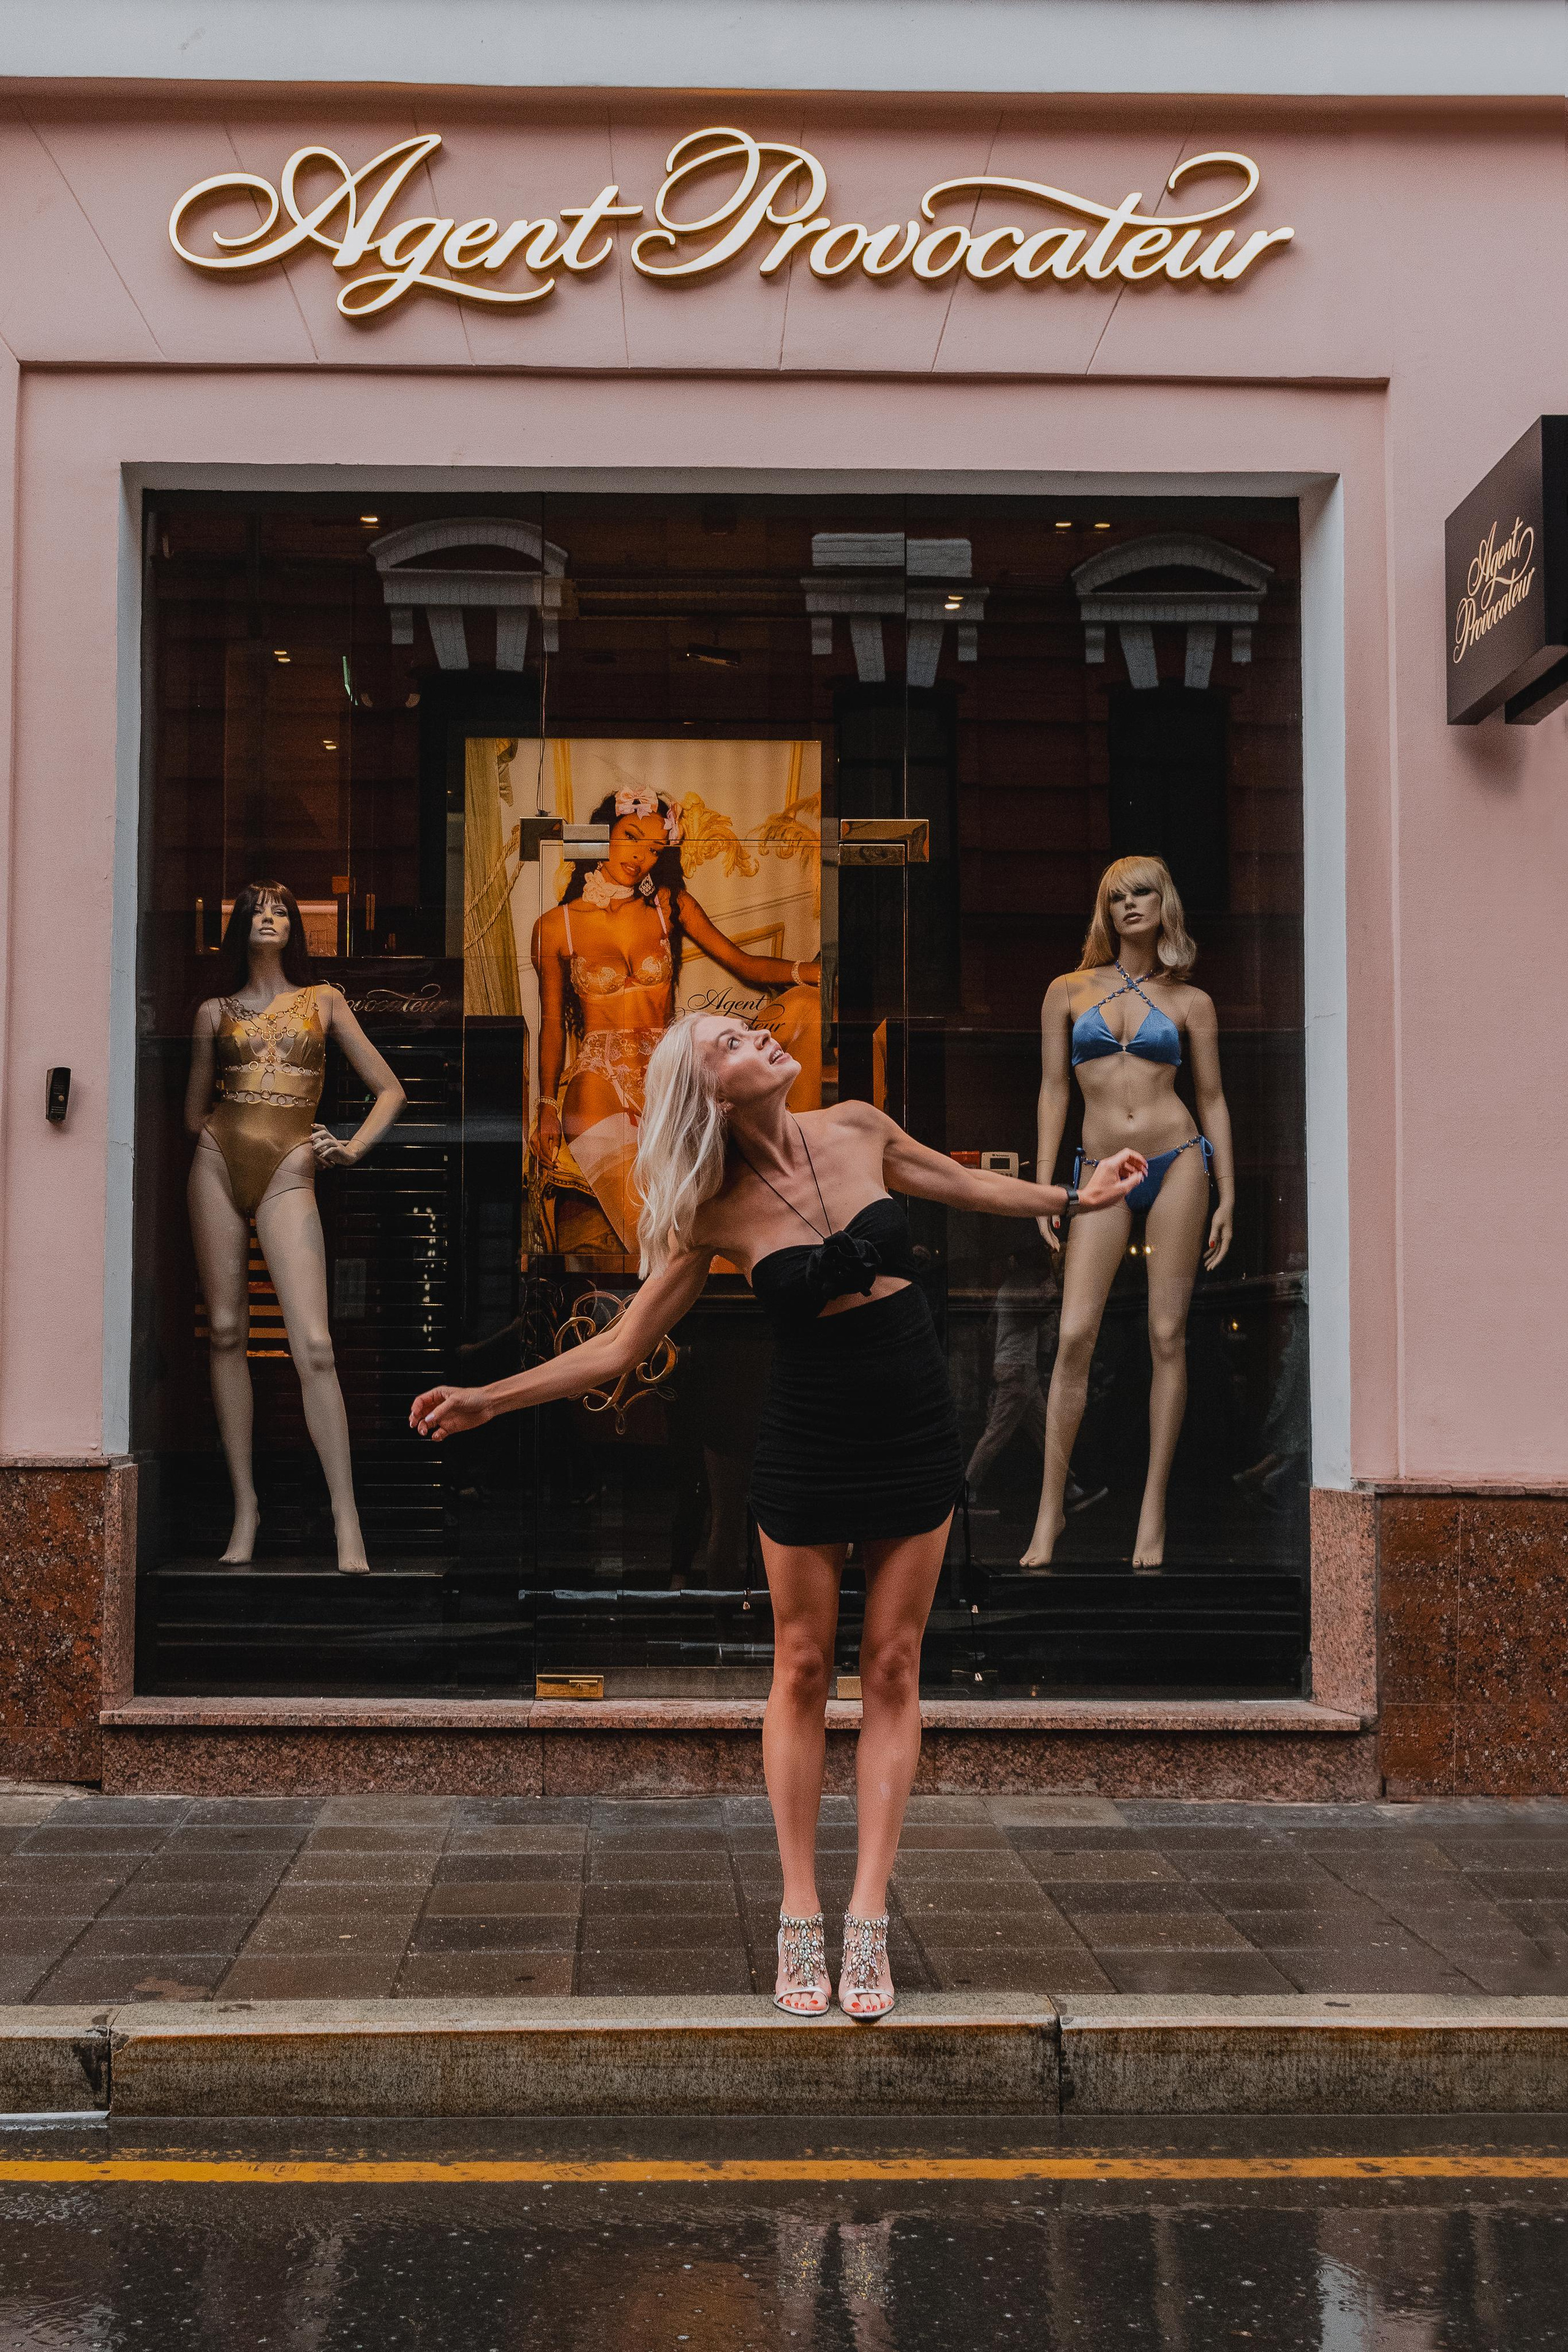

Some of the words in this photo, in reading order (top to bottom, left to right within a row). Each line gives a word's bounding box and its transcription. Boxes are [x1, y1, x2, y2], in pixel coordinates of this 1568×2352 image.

[168, 133, 644, 318] Agent
[630, 126, 1295, 281] Provocateur
[1468, 516, 1534, 611] Agent
[1453, 567, 1535, 664] Provocateur
[687, 986, 785, 1022] Agent
